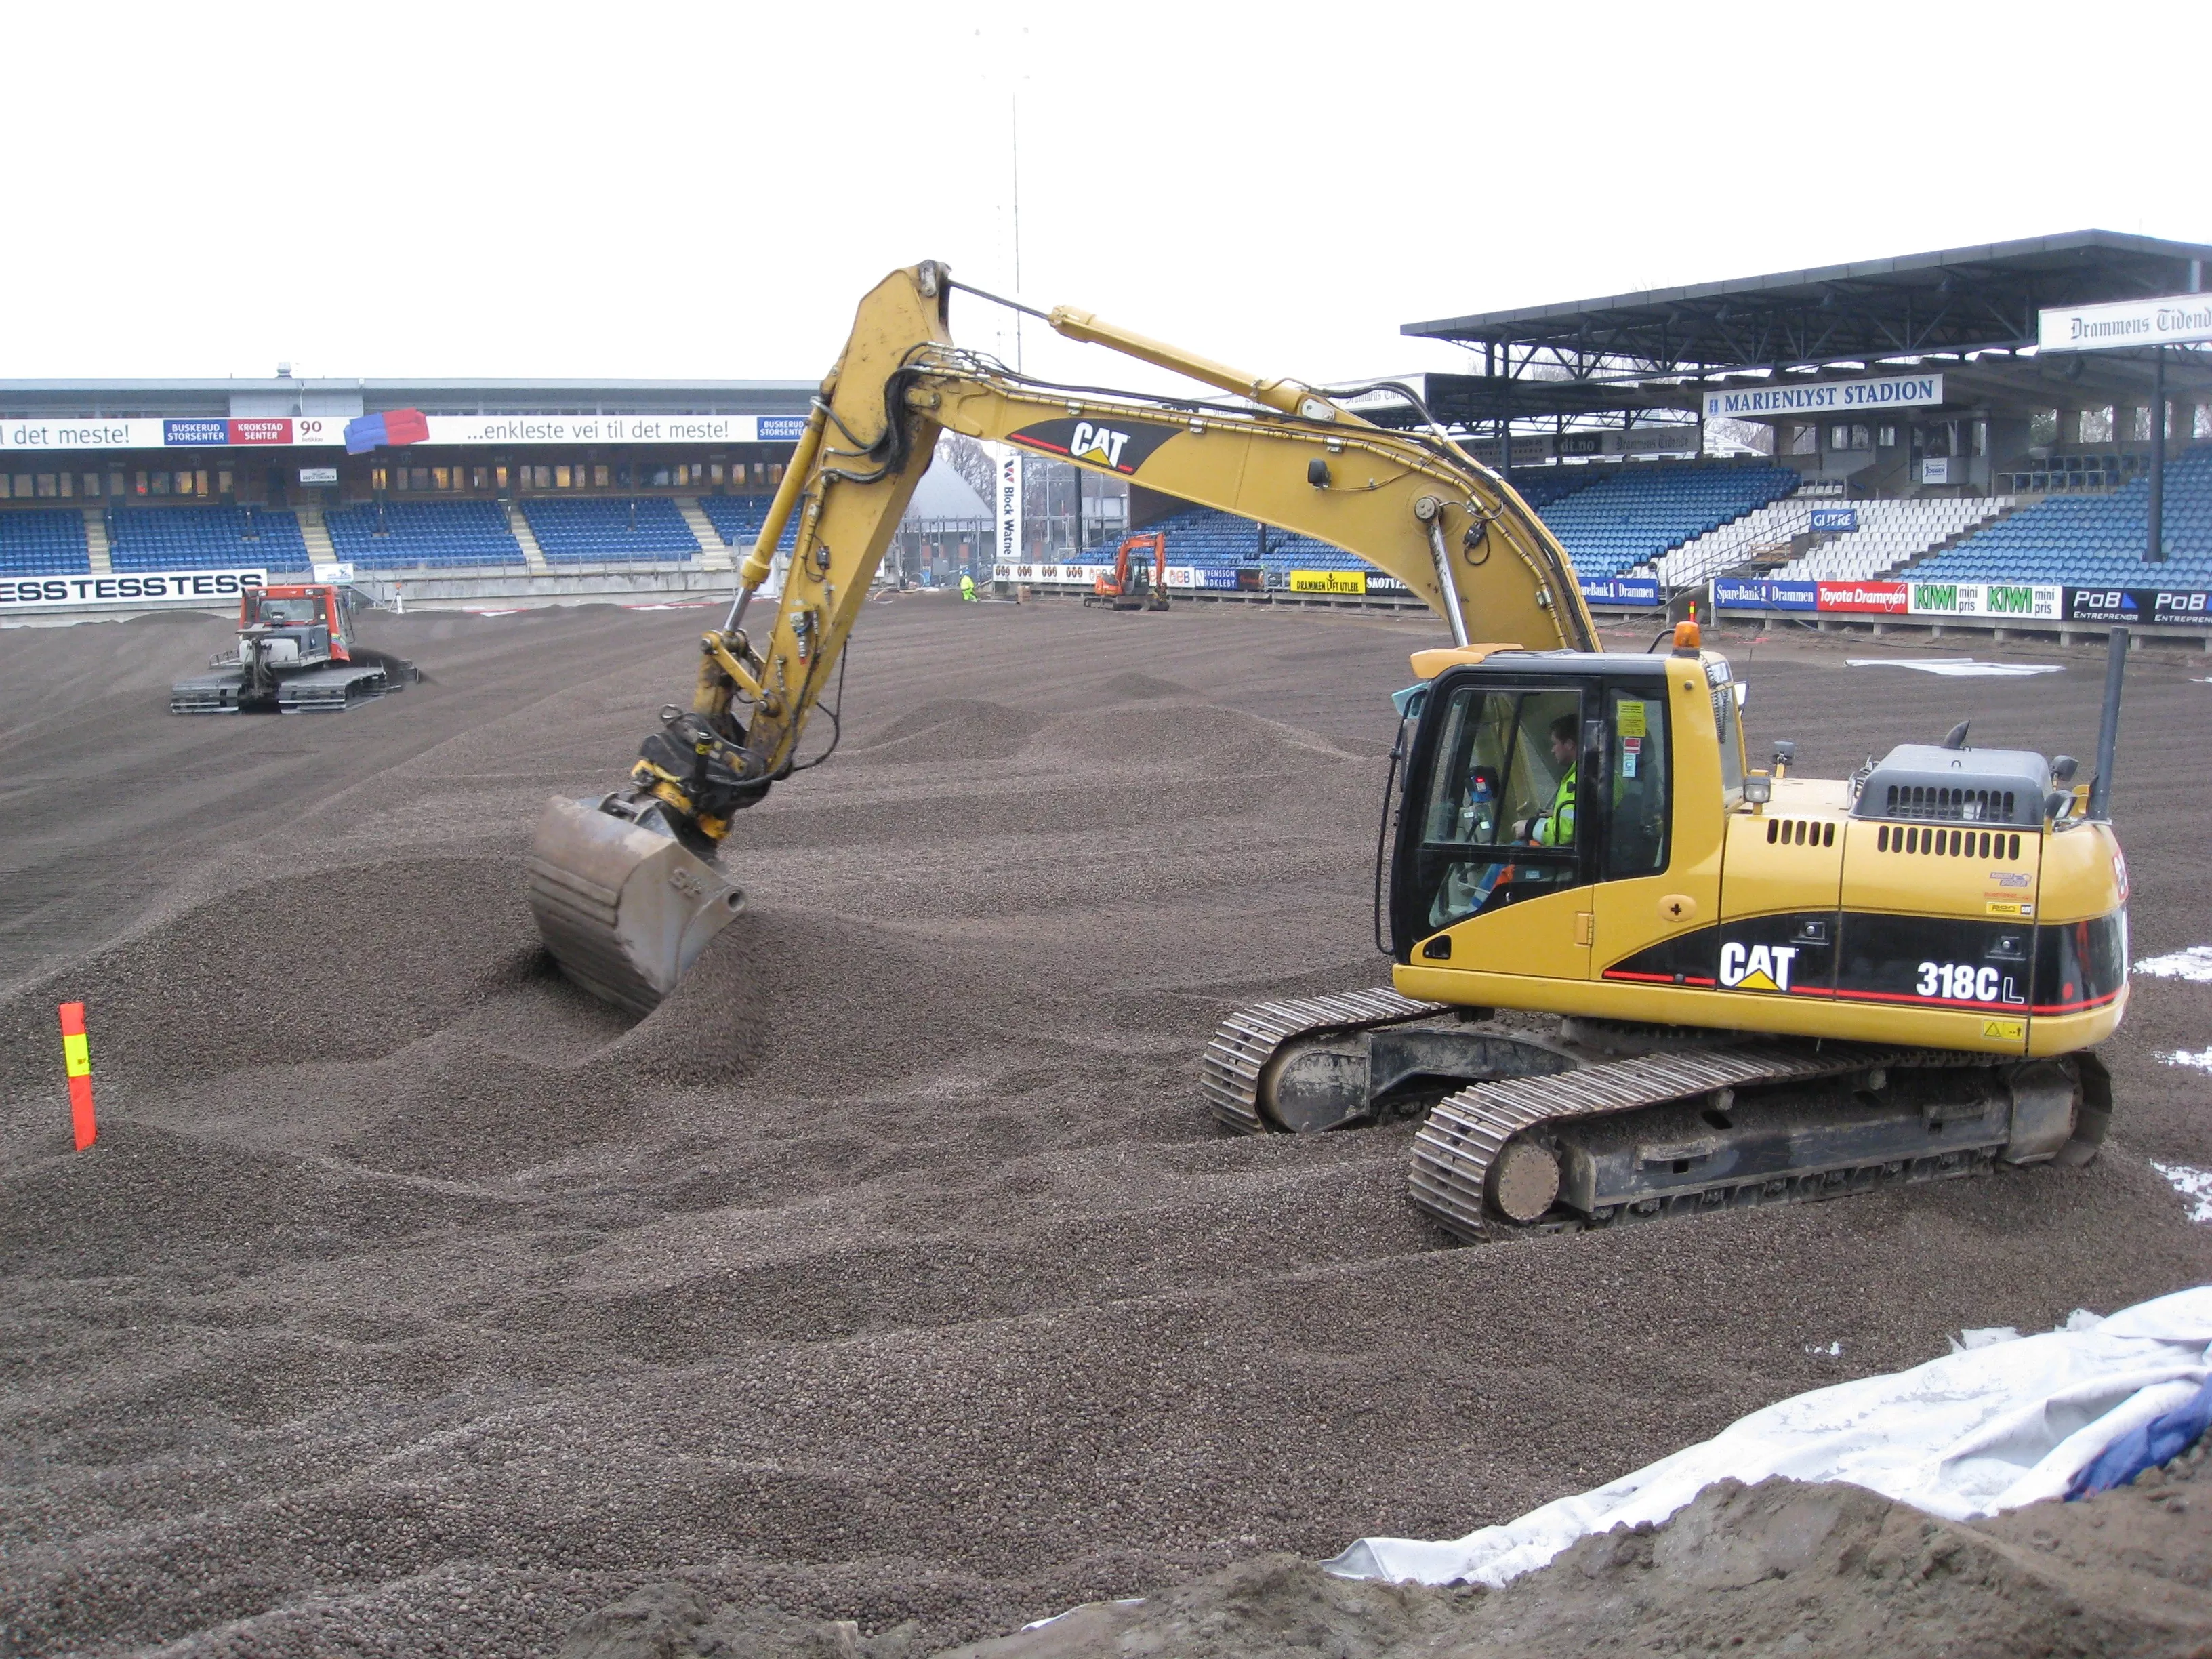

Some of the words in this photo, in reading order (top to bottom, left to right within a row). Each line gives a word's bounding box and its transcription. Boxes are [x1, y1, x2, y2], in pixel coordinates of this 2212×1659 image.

[2070, 317, 2150, 340] Drammens
[2156, 306, 2212, 331] Tidend
[1724, 387, 1837, 411] MARIENLYST
[1844, 380, 1933, 404] STADION
[171, 423, 220, 432] BUSKERUD
[238, 423, 283, 432] KROKSTAD
[300, 420, 322, 436] 90
[572, 420, 598, 438] vei
[607, 420, 624, 438] til
[632, 420, 661, 438] det
[669, 420, 729, 438] meste!
[764, 420, 804, 428] BUSKERUD
[14, 424, 49, 445] det
[59, 424, 129, 444] meste!
[167, 432, 224, 441] STORSENTER
[245, 432, 278, 441] SENTER
[1071, 422, 1129, 468] CAT
[1561, 438, 1595, 452] dt.no
[1004, 487, 1014, 516] Block
[1004, 519, 1015, 555] Watne
[1204, 569, 1235, 577] SVENSSON
[0, 580, 68, 602] ESS
[70, 577, 167, 598] TESS
[169, 573, 263, 595] TESS
[1204, 578, 1236, 588] NØKLEBY
[1296, 580, 1326, 591] DRAMMEN
[1340, 581, 1359, 592] UTLEIE
[1580, 581, 1609, 597] areBank
[1618, 583, 1654, 598] Drammen
[1717, 584, 1760, 603] SpareBank
[1771, 586, 1814, 602] Drammen
[1820, 588, 1853, 607] Toyota
[1854, 588, 1906, 605] Drammen
[1914, 584, 1957, 611] KIWI
[1959, 586, 1978, 598] mini
[1987, 586, 2032, 613] KIWI
[2035, 588, 2055, 600] mini
[1959, 600, 1975, 614] pris
[2035, 602, 2052, 616] pris
[2154, 613, 2212, 623] ENTREPREN
[1719, 942, 1796, 991] CAT
[1916, 962, 1999, 1002] 318C
[2002, 977, 2025, 1004] L
